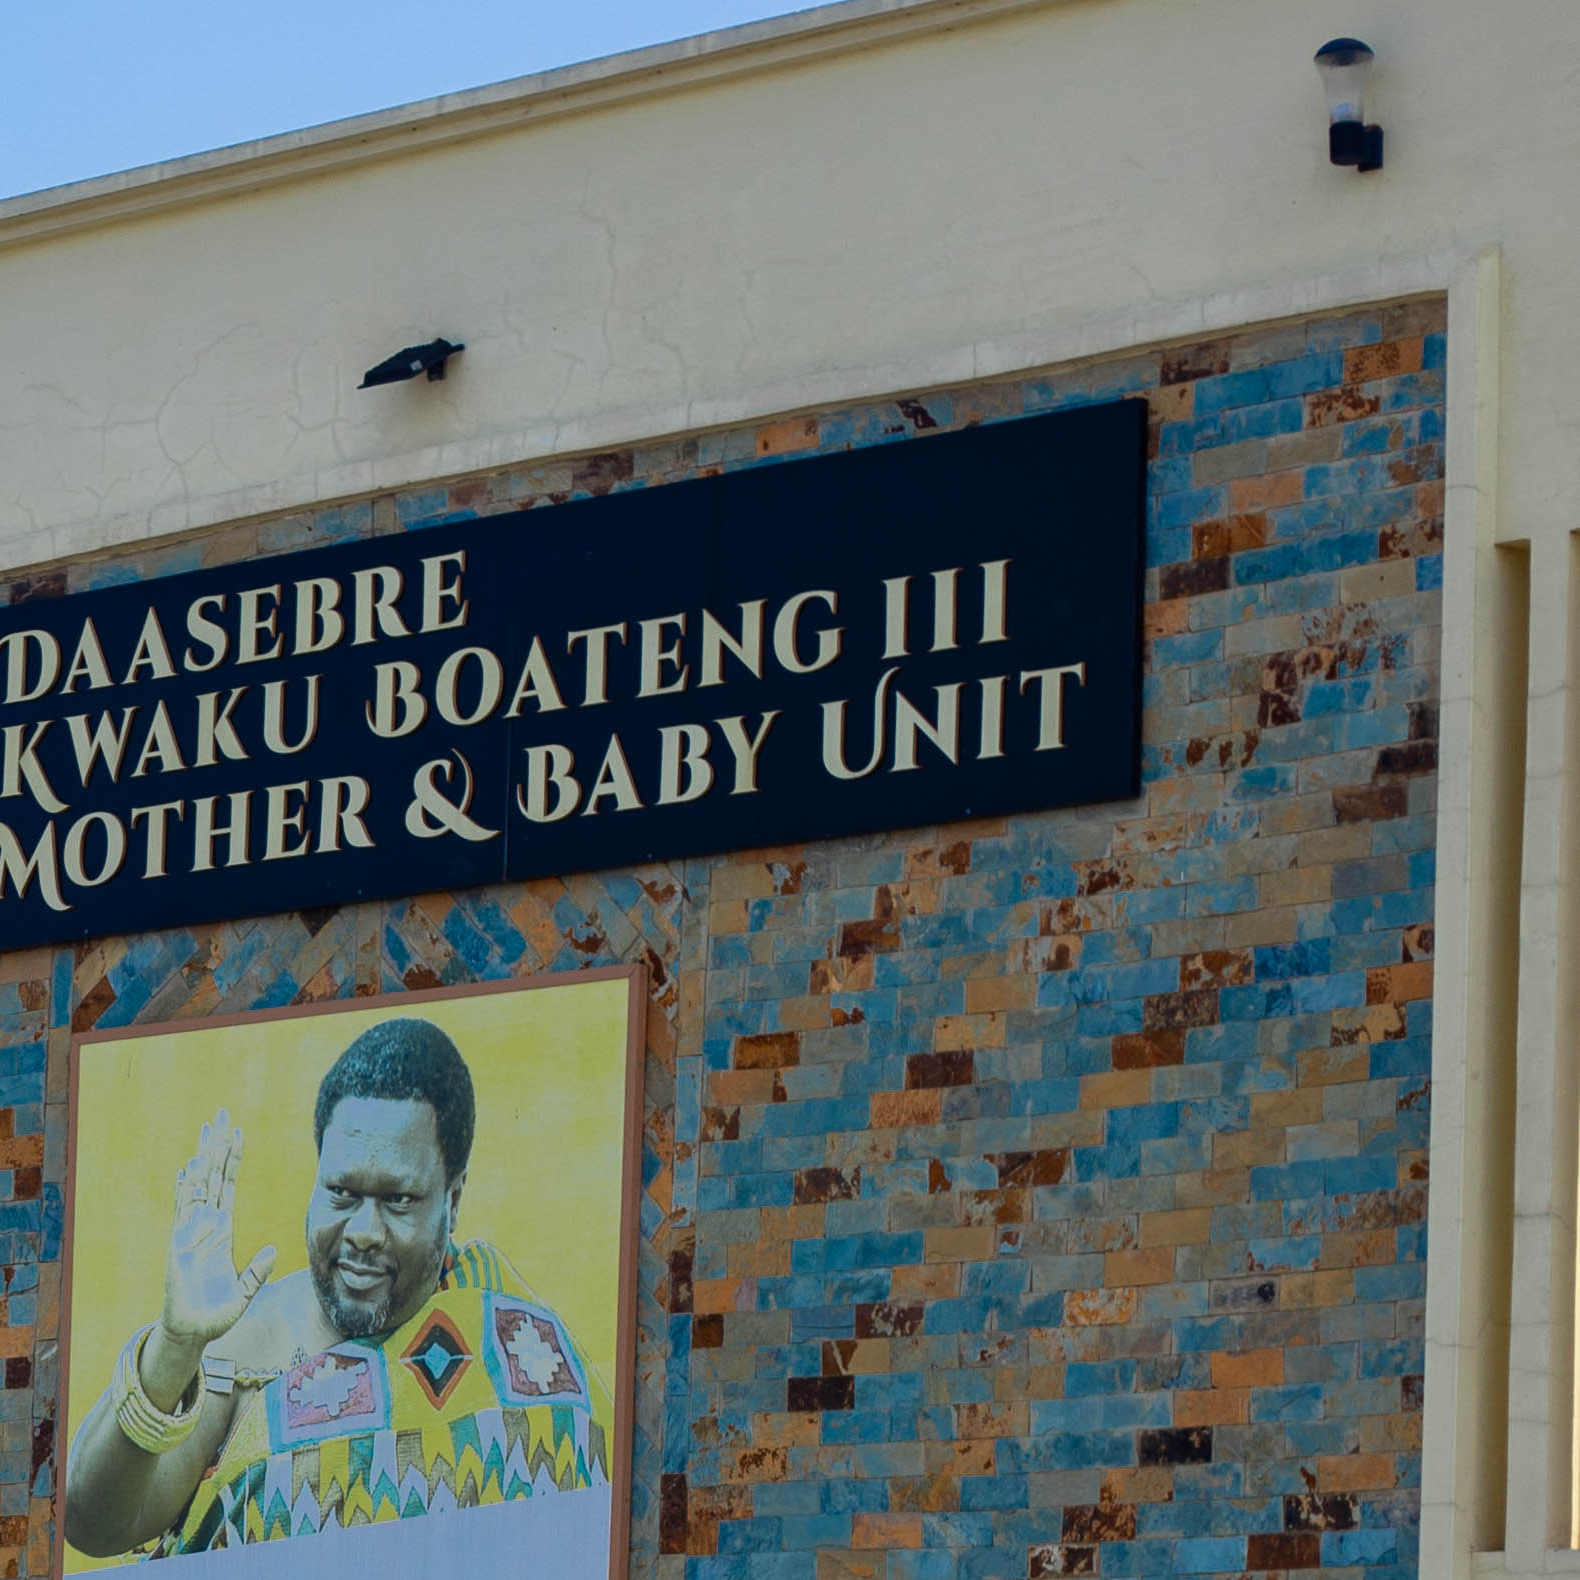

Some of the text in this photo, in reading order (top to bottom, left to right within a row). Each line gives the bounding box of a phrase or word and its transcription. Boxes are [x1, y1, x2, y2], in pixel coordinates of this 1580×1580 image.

[0, 558, 1014, 814] KWAKU BOATENG III
[404, 747, 503, 842] &
[517, 709, 783, 823] BABY
[820, 662, 1088, 780] UNIT
